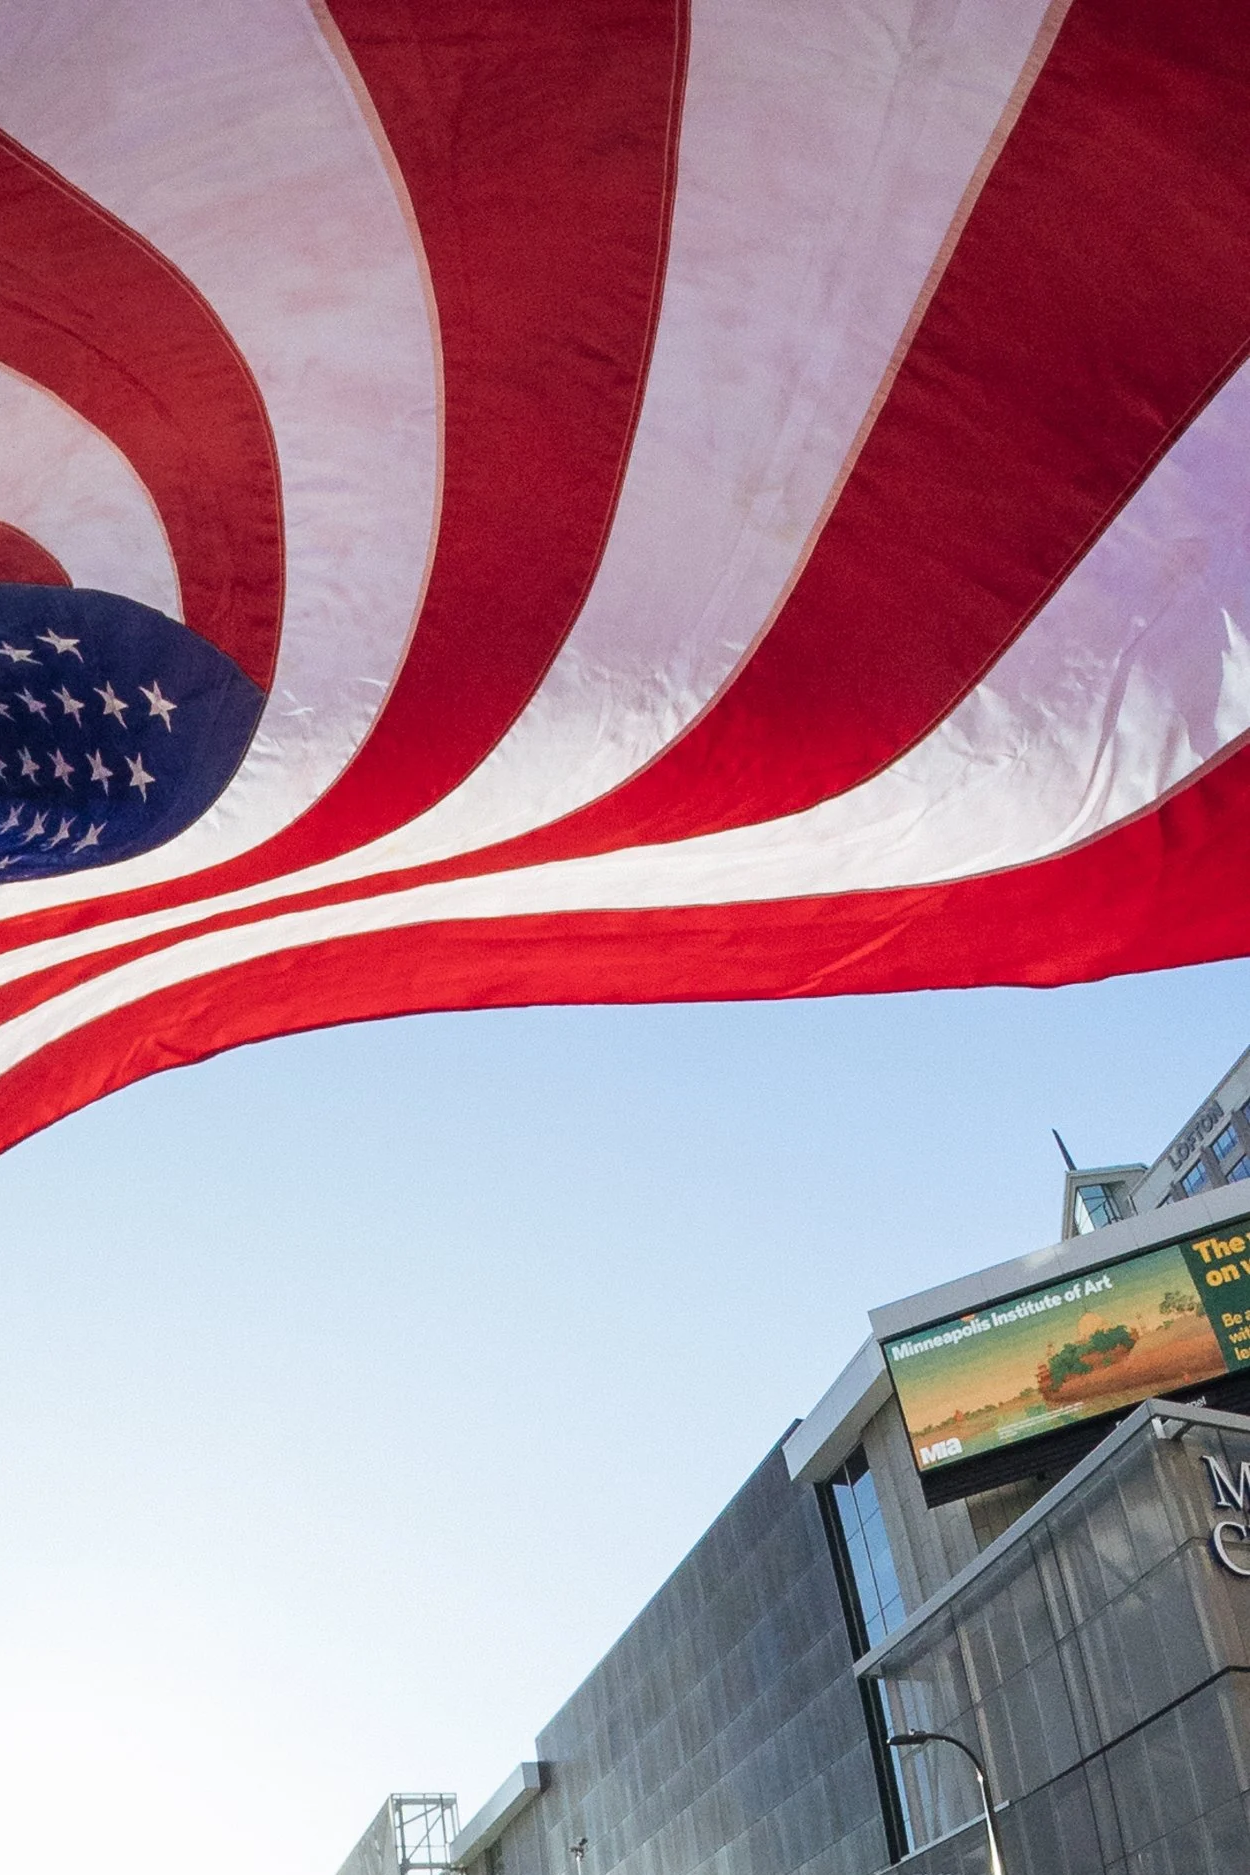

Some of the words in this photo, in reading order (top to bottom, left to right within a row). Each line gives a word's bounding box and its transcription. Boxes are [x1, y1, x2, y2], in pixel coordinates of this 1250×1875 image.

[1169, 1099, 1224, 1171] LOFTON
[1191, 1235, 1246, 1264] The
[1205, 1263, 1241, 1287] on
[891, 1315, 991, 1361] Minneapolis
[991, 1294, 1062, 1327] Institute
[1063, 1283, 1082, 1303] of
[1084, 1274, 1113, 1298] Art
[1221, 1311, 1243, 1328] Be
[919, 1436, 963, 1466] Mia
